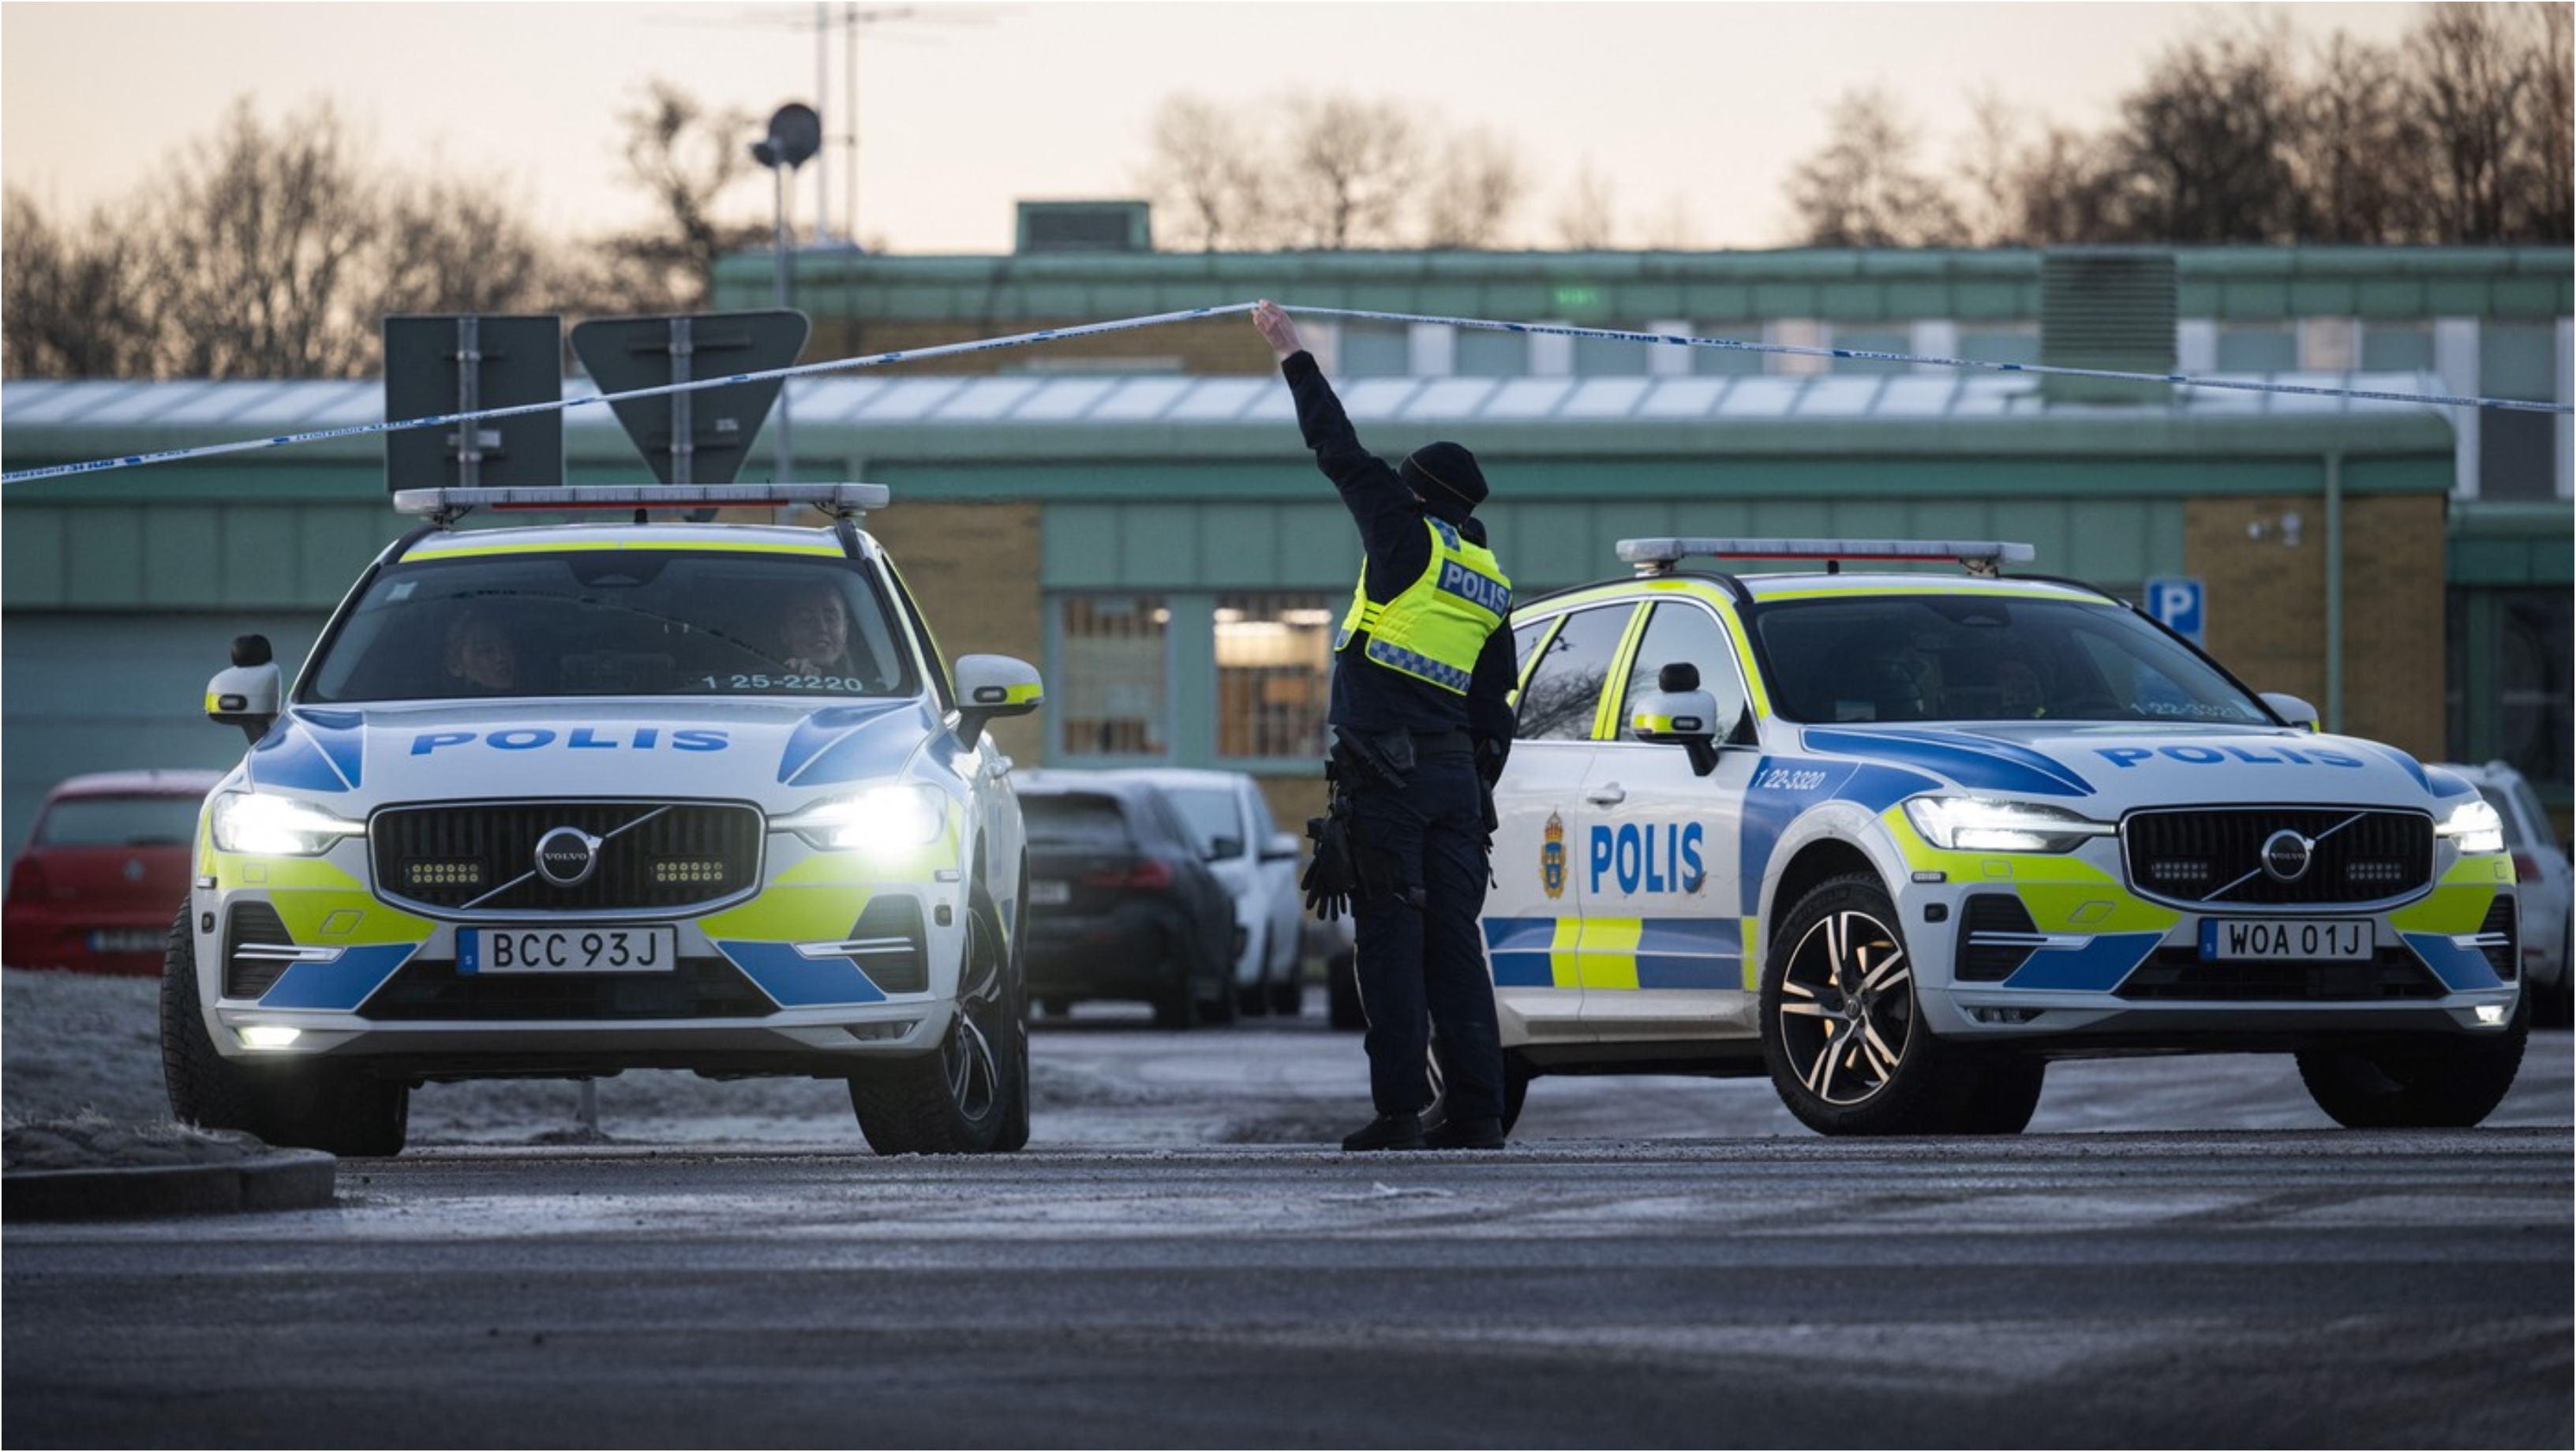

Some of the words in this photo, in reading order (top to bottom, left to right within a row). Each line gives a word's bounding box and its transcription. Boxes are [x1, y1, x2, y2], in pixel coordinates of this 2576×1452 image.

[1443, 563, 1506, 612] POLIS
[2162, 587, 2193, 627] P
[702, 676, 717, 689] 1
[730, 675, 863, 692] 25-2220
[410, 728, 729, 756] POLIS
[2093, 746, 2364, 767] POLIS
[1754, 768, 1768, 788] 1
[1590, 821, 1704, 894] POLIS
[493, 934, 567, 967] BCC
[581, 933, 657, 967] 93J
[2230, 925, 2290, 955] WOA
[2302, 925, 2359, 955] 01J
